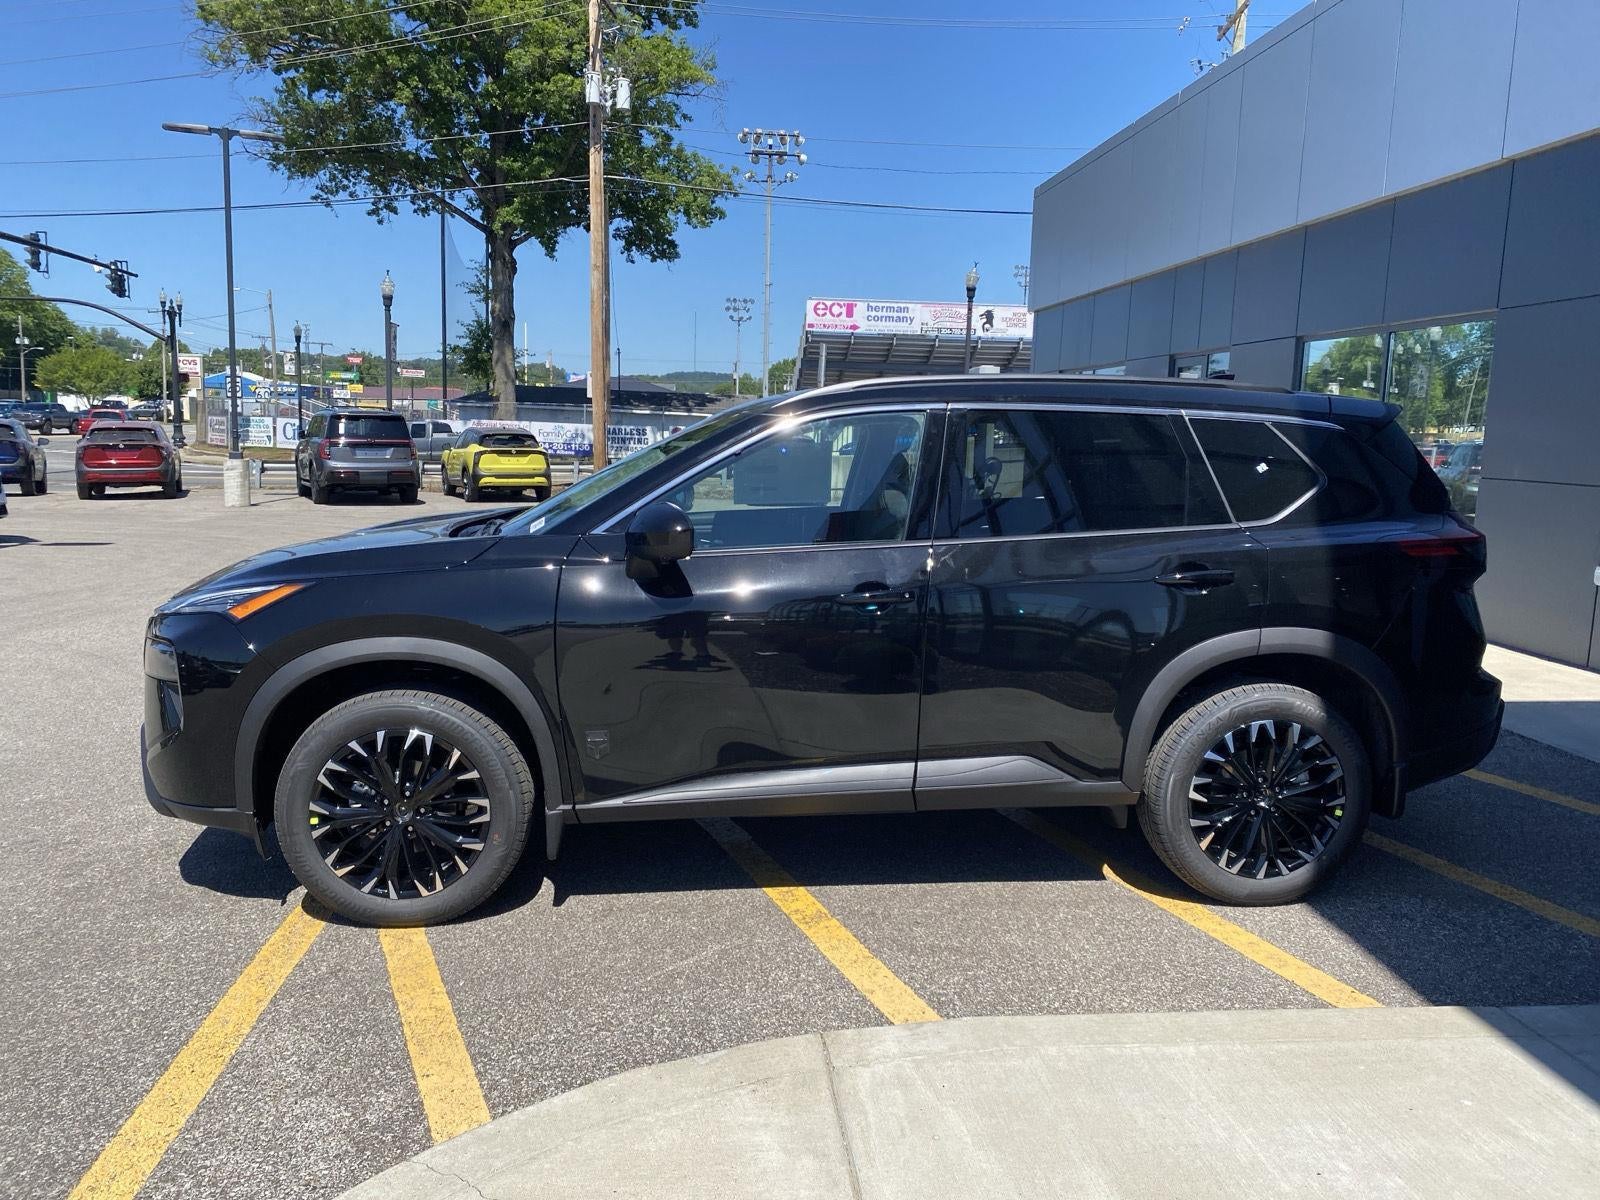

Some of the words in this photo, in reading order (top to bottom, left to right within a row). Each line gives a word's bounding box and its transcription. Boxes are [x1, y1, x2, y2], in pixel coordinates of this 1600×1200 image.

[866, 303, 910, 313] herman
[866, 314, 915, 325] cormany
[256, 390, 270, 399] 60
